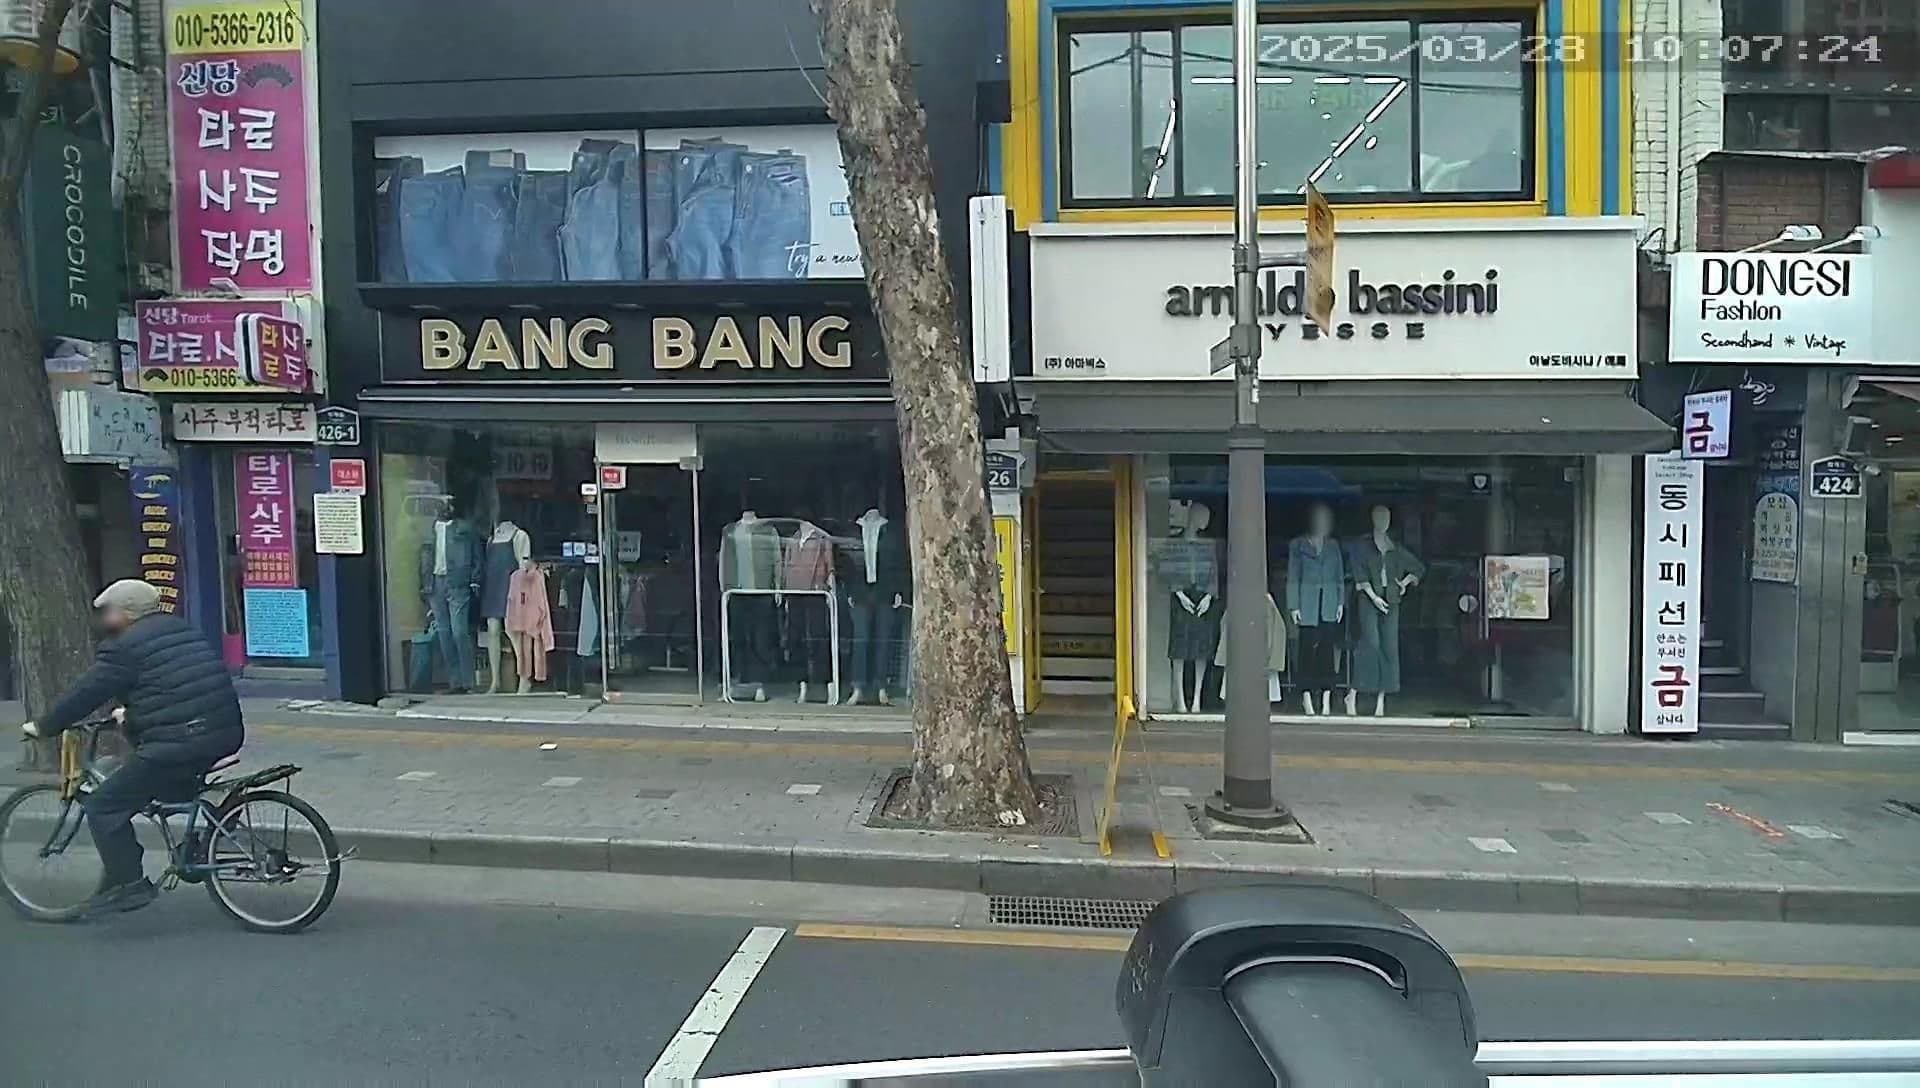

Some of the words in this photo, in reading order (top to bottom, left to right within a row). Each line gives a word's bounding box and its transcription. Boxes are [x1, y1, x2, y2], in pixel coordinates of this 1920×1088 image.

[175, 11, 294, 48] 010-5366-2316
[177, 59, 239, 97] 신당
[197, 107, 277, 151] 타로
[199, 166, 280, 213] 사주
[63, 144, 88, 310] CROCODILE
[1164, 269, 1337, 318] arnld
[1349, 269, 1499, 315] bassini
[1701, 258, 1851, 297] DONGSI
[144, 307, 179, 326] 신당
[1701, 298, 1782, 321] Fashion
[420, 316, 615, 371] BANG
[651, 314, 853, 370] BANG
[1265, 322, 1427, 341] YESSE
[1701, 329, 1773, 349] Secondhand
[1804, 333, 1847, 357] Vintage
[318, 425, 356, 441] 426-1
[1686, 411, 1714, 454] 금
[1819, 475, 1854, 494] 424
[1657, 483, 1689, 626] 동시패션
[1650, 665, 1692, 708] 금
